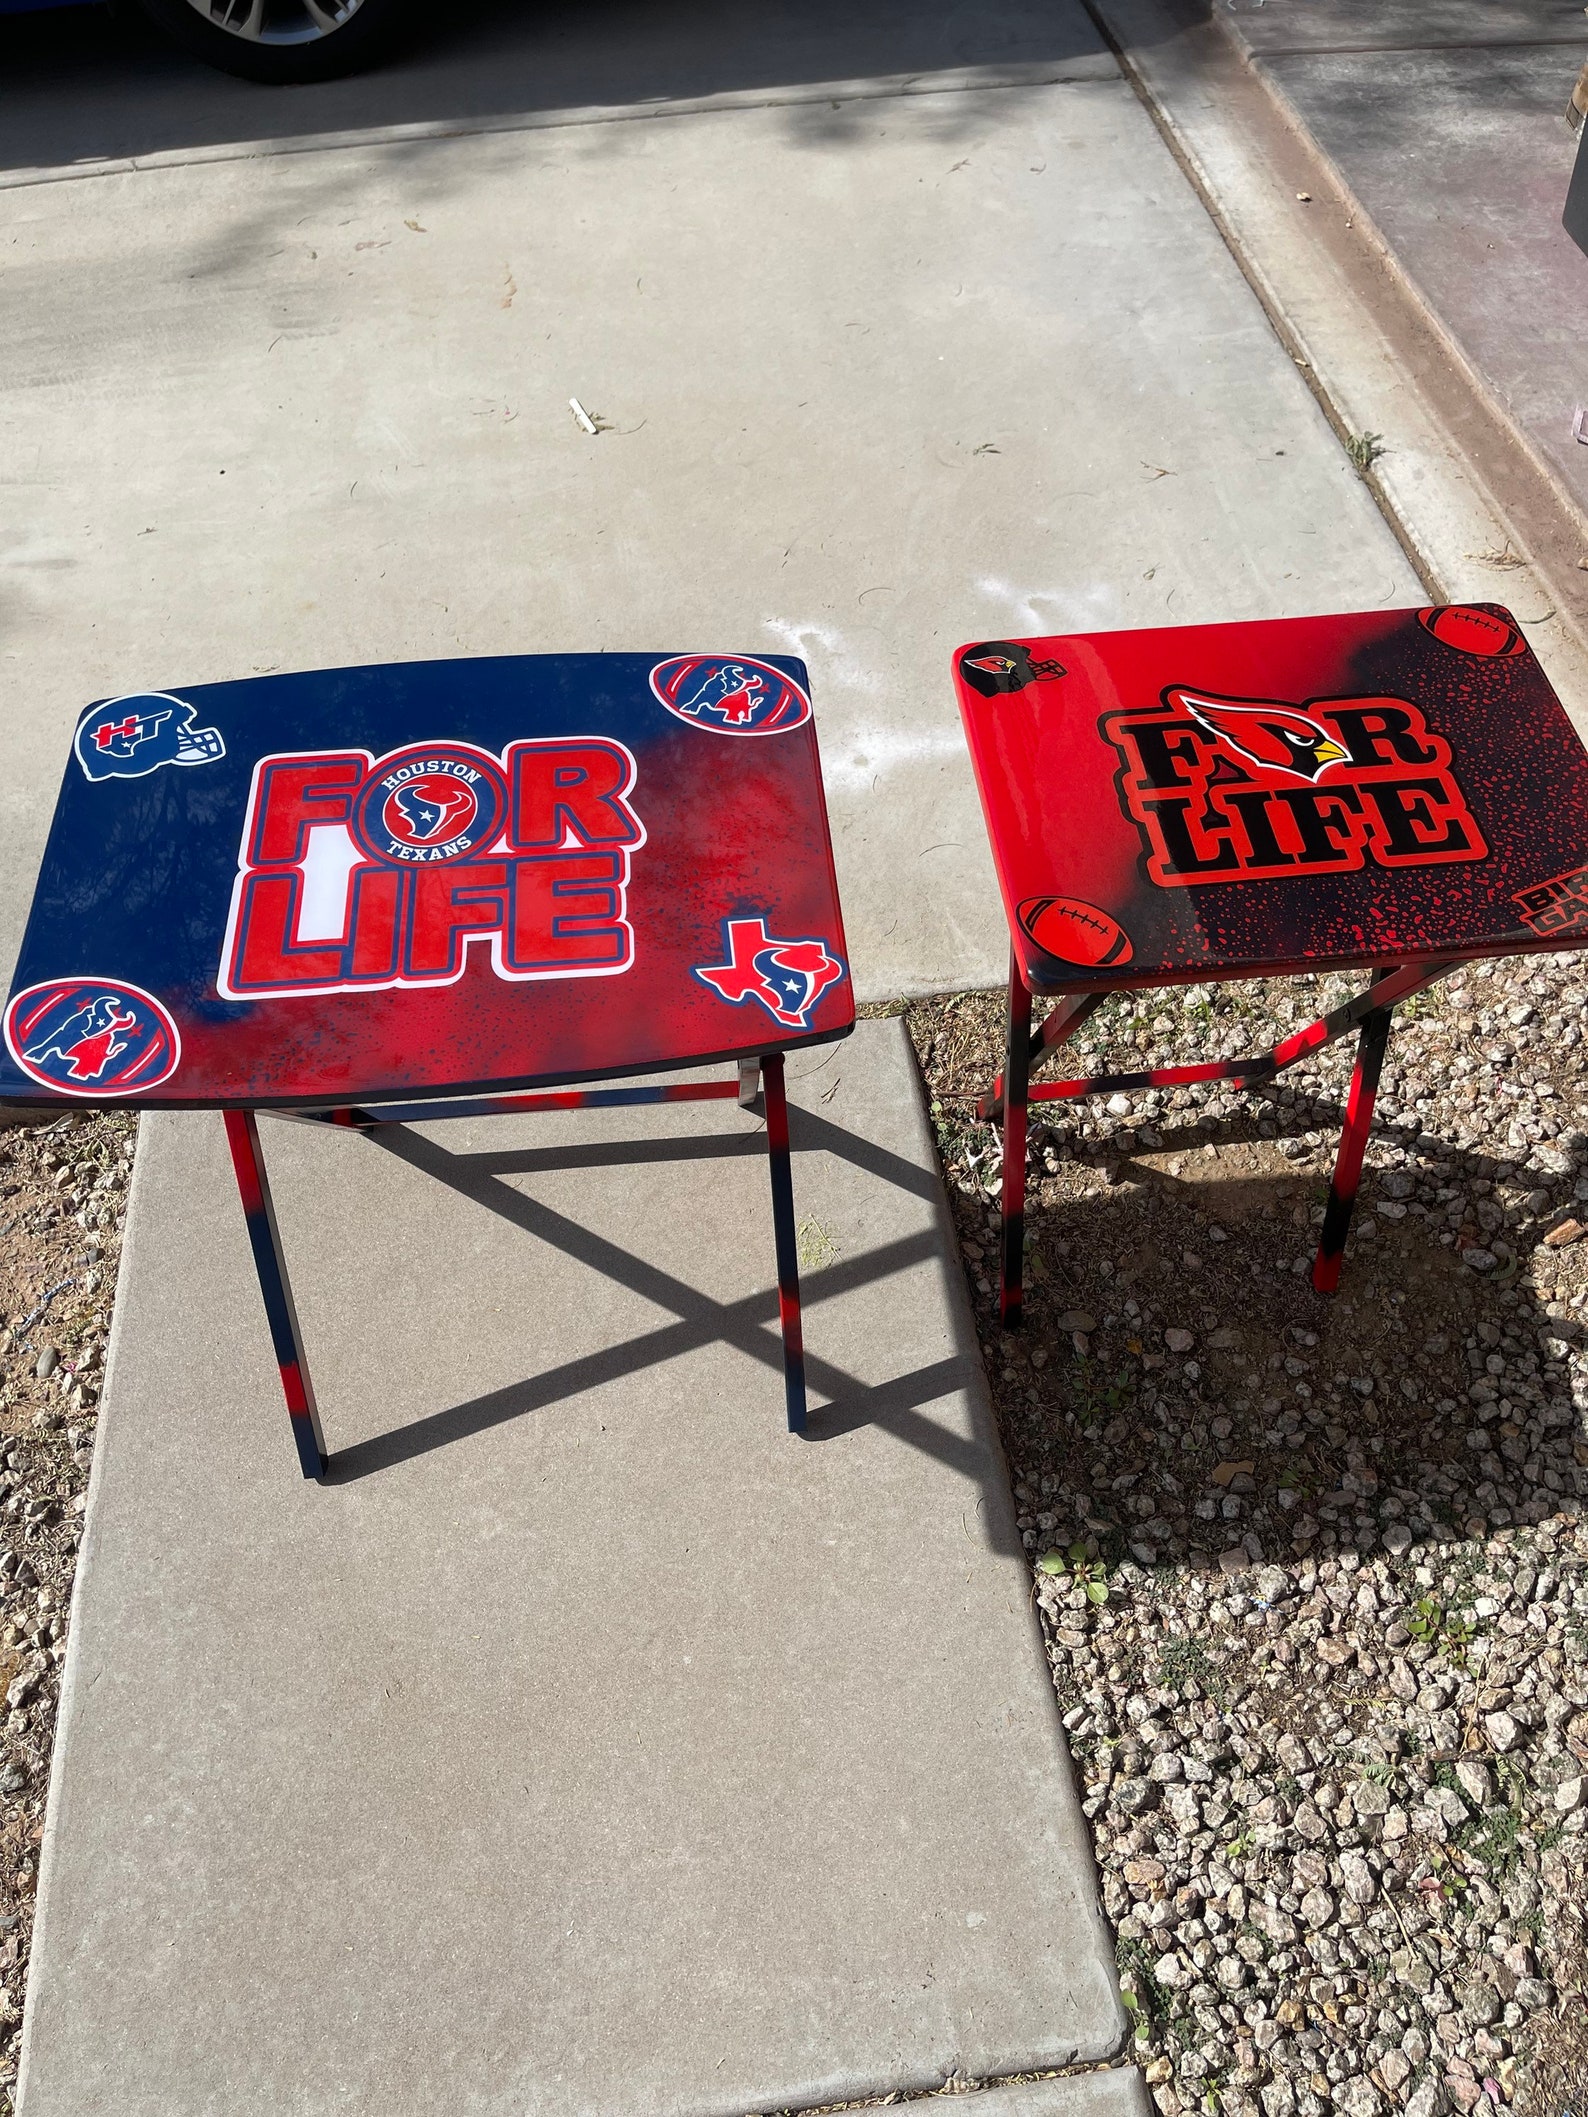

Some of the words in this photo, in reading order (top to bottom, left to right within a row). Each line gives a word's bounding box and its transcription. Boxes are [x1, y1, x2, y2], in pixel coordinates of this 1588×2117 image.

[381, 760, 482, 790] HOUSTON
[386, 836, 472, 861] TEXANS
[1144, 777, 1472, 874] LIFE
[229, 851, 625, 989] LIFE
